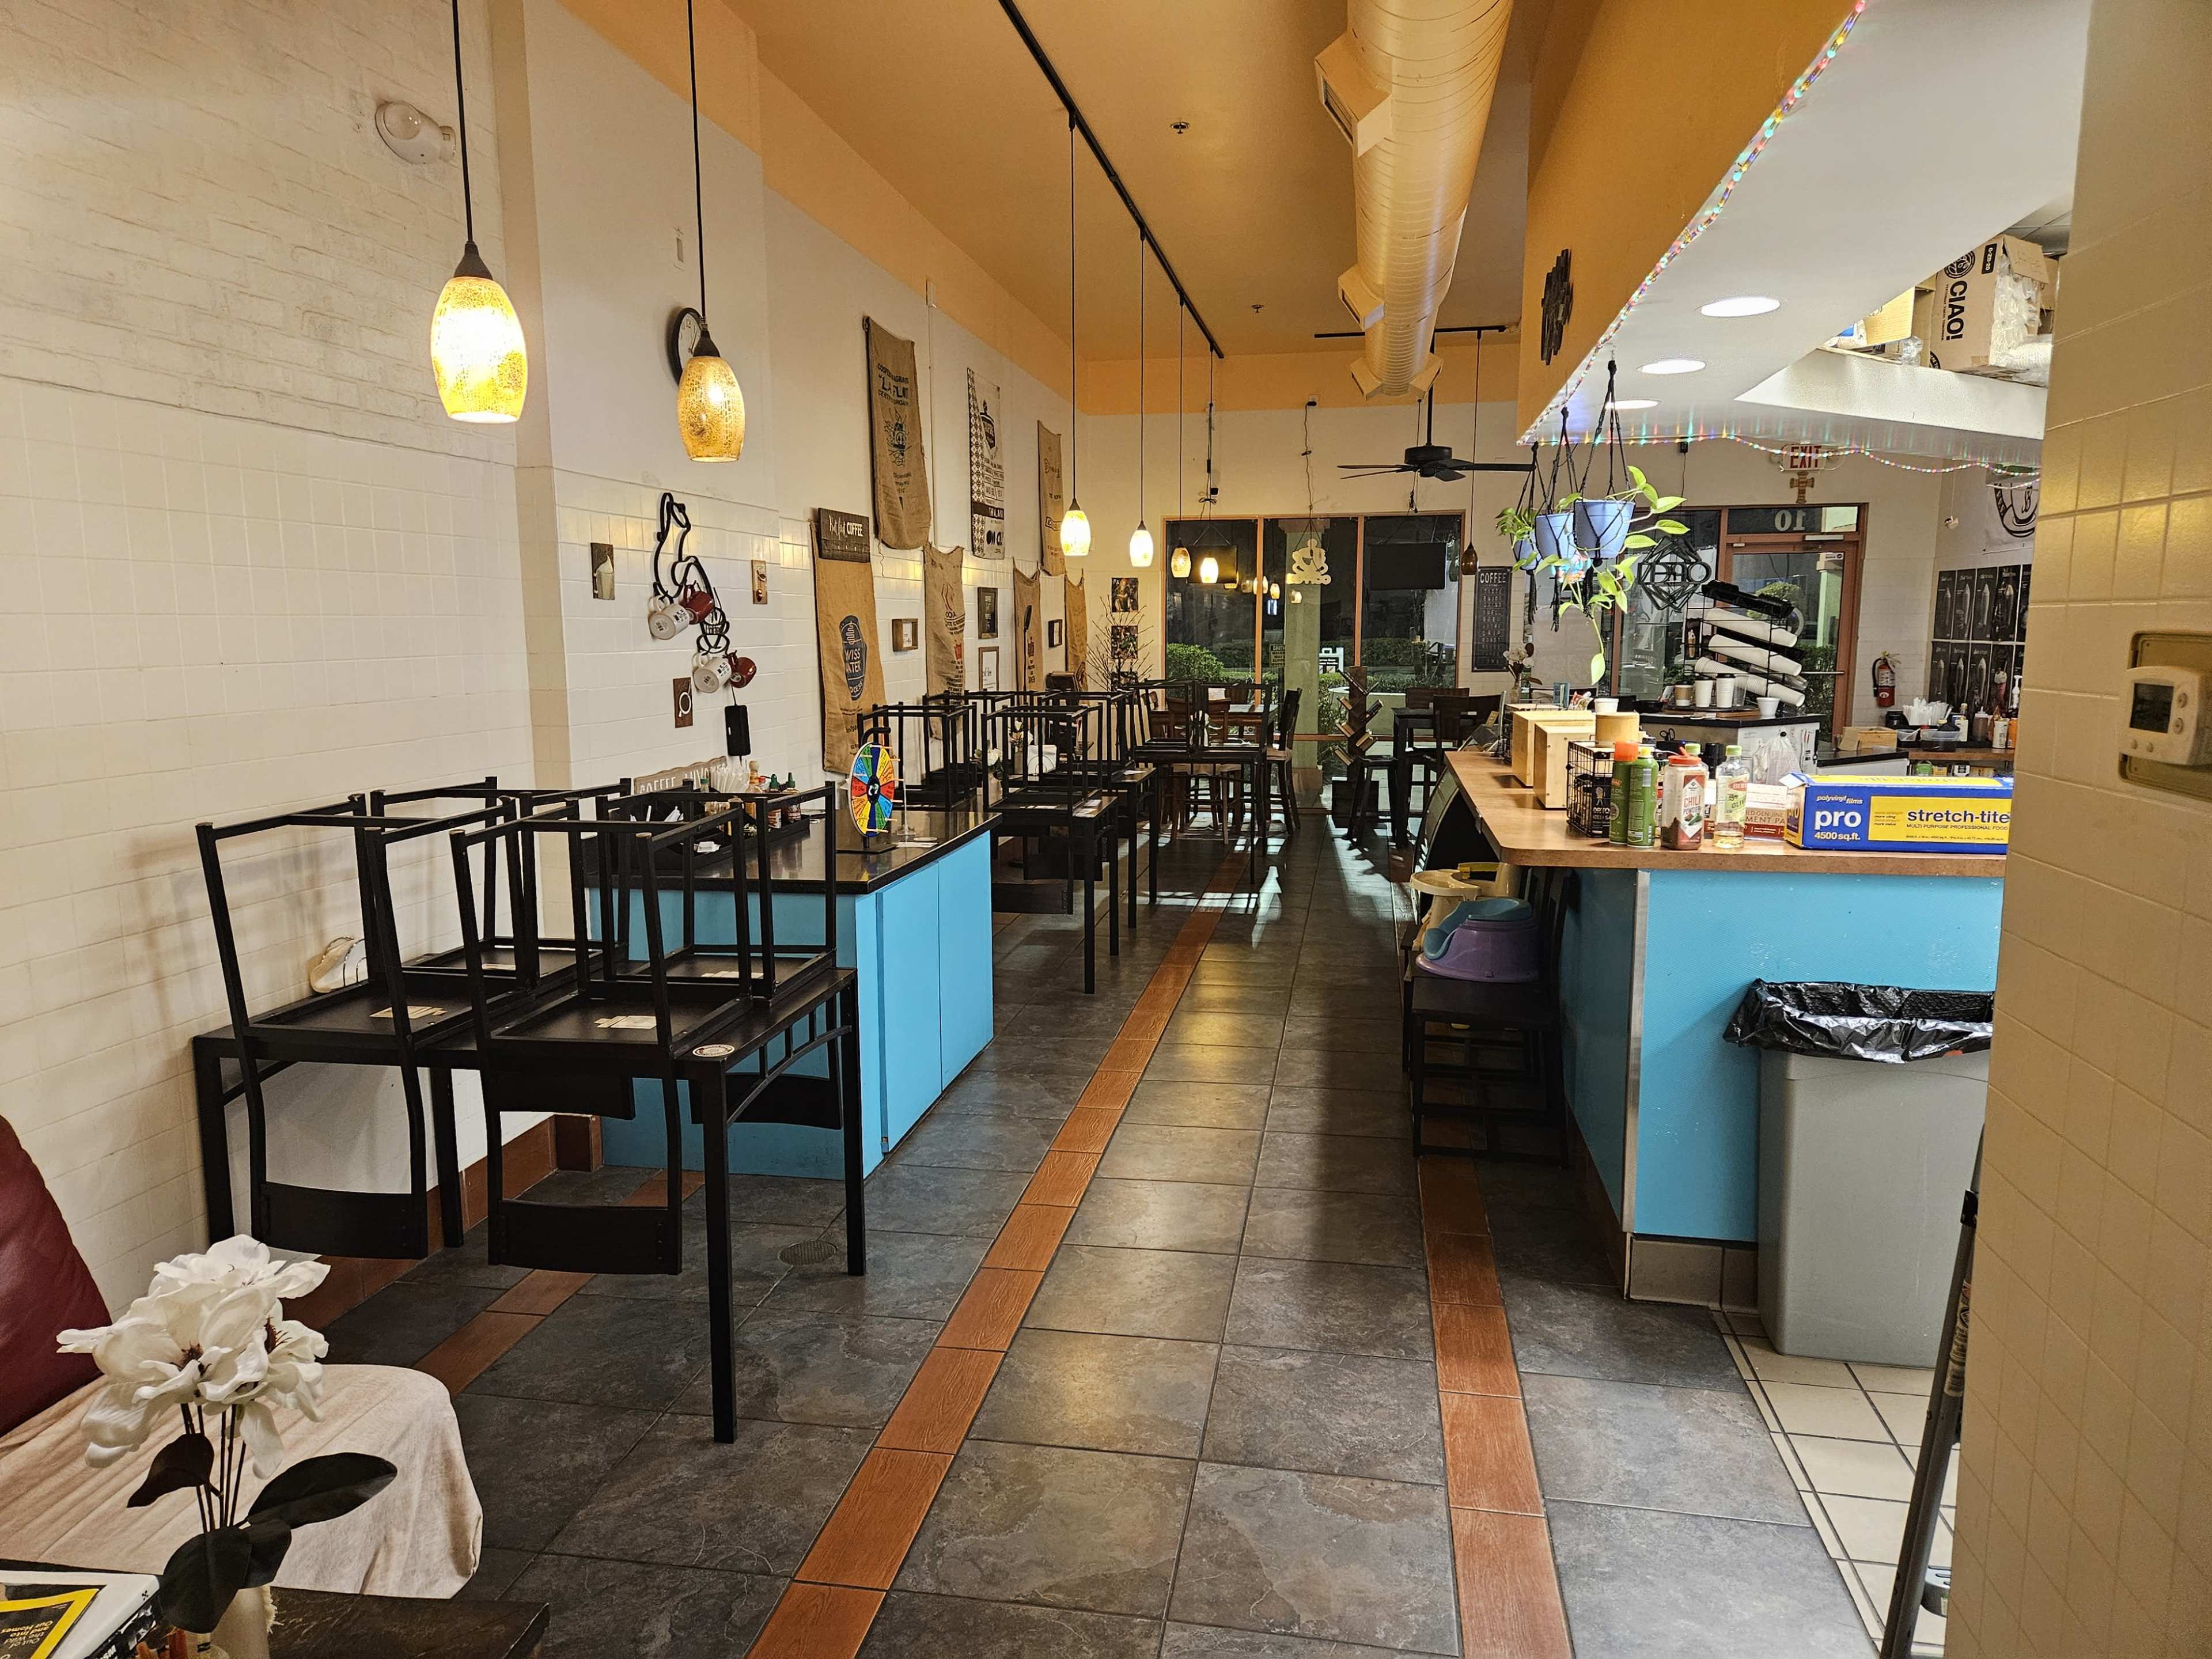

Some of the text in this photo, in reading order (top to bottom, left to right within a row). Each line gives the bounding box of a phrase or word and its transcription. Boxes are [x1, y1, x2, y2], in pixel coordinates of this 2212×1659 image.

[1946, 281, 1968, 341] CIAO!
[1790, 445, 1821, 468] EXIT
[847, 522, 863, 537] COFFEE
[1480, 573, 1506, 584] COFFEE
[1815, 810, 1862, 830] pro
[1907, 809, 2010, 824] stretch-tite
[1838, 832, 1861, 842] sq.ft.
[1, 1620, 54, 1634] Our Homes
[29, 1626, 50, 1635] and
[3, 1636, 26, 1645] Wild
[9, 1641, 21, 1649] of
